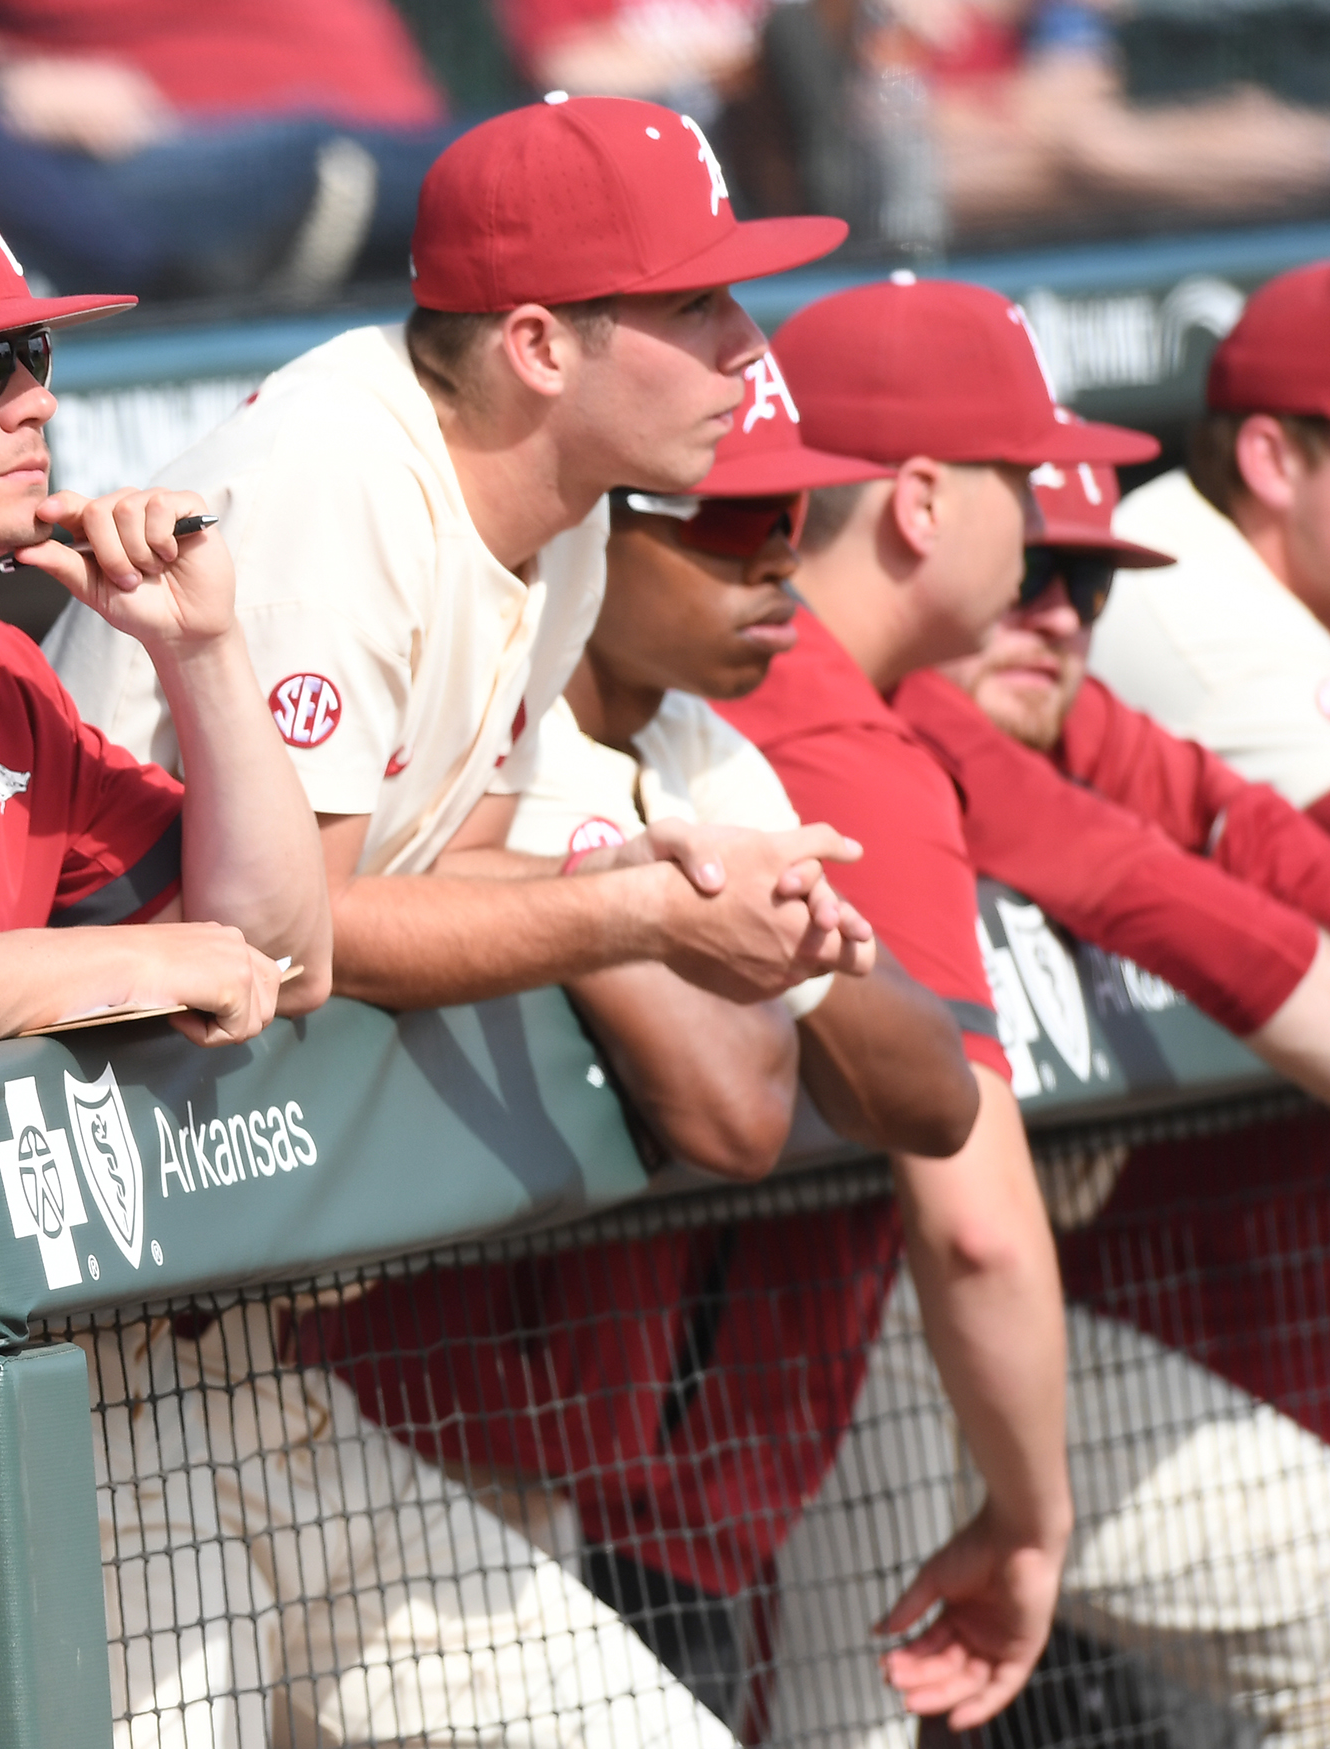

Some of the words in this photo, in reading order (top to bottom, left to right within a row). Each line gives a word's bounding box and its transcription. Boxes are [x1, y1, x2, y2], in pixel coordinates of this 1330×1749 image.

[742, 351, 800, 434] A
[274, 675, 339, 743] SEC
[153, 1100, 318, 1198] Arkansas
